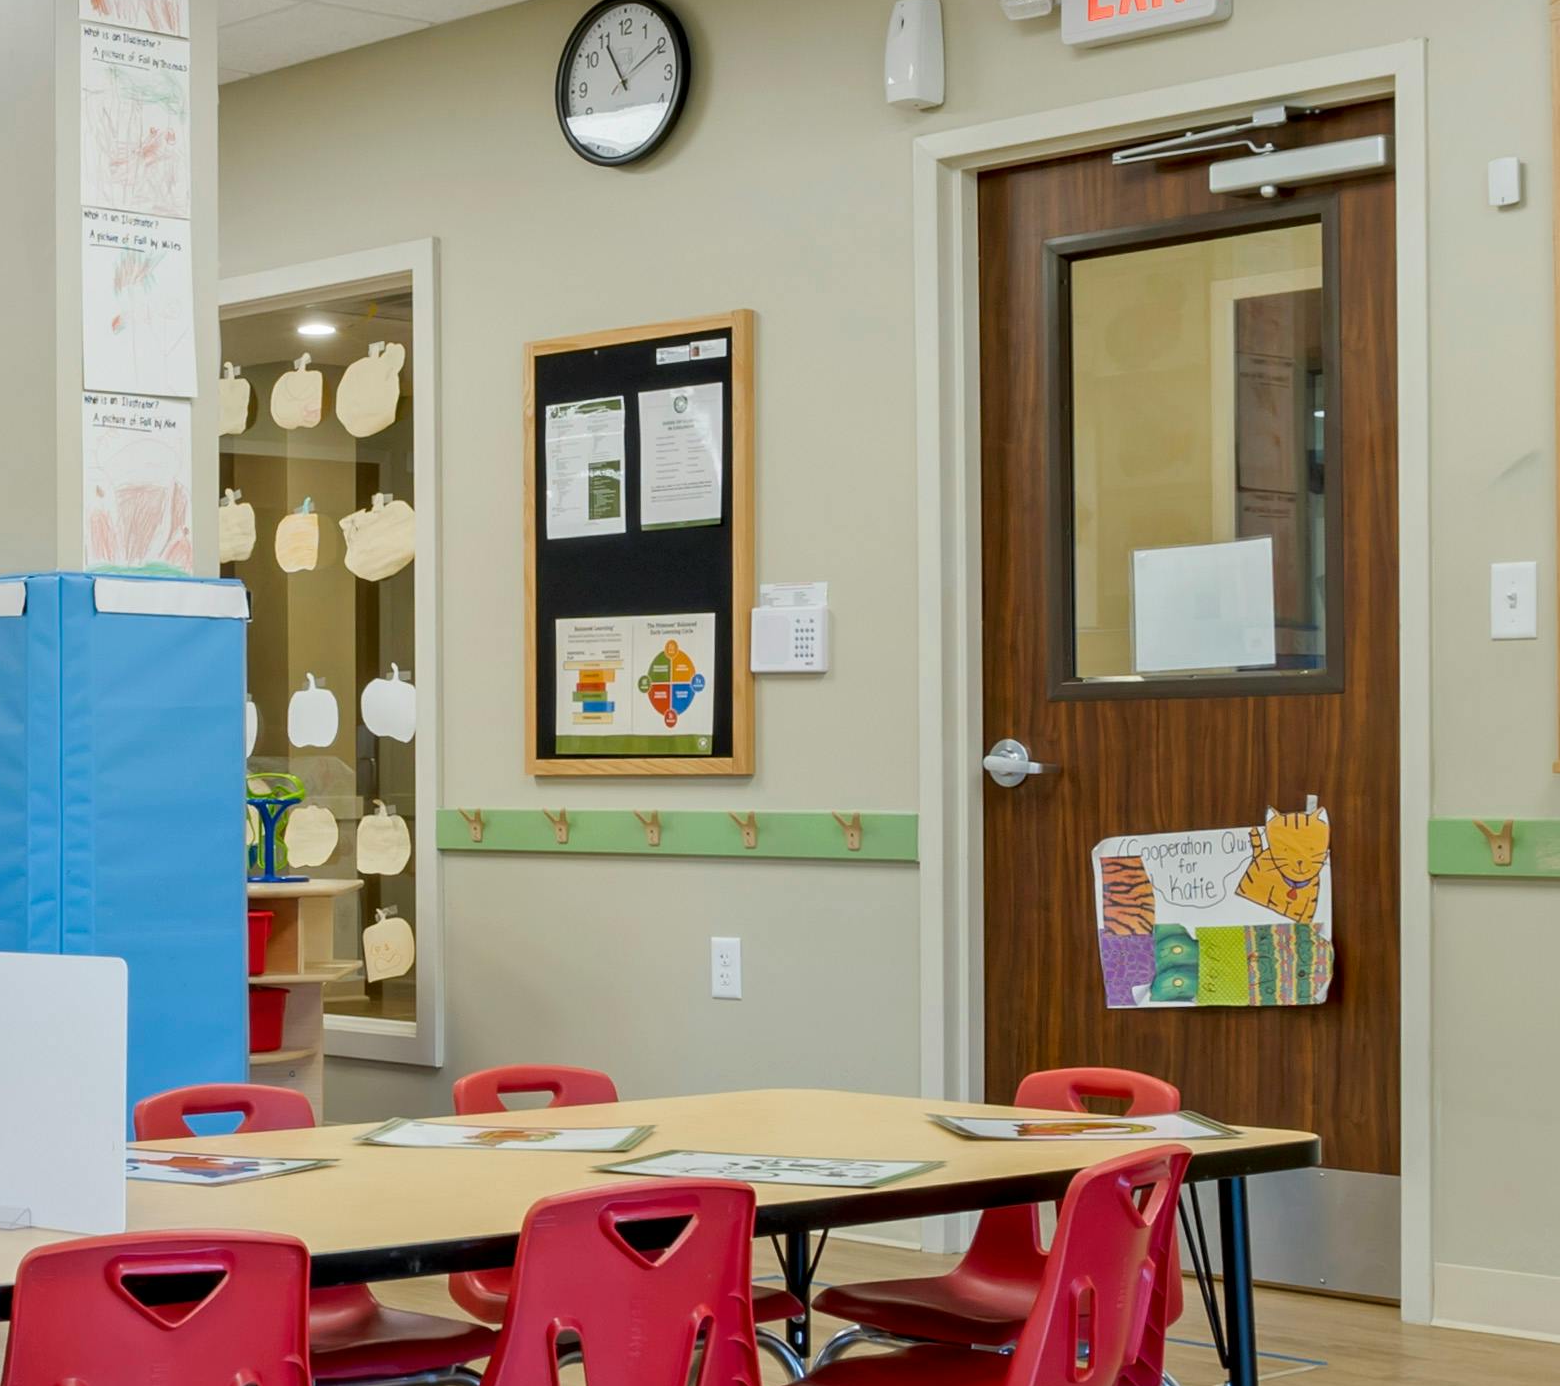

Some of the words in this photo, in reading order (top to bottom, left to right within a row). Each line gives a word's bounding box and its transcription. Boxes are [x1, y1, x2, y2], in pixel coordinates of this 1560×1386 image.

[619, 17, 633, 36] 12
[642, 23, 649, 40] 1
[598, 31, 611, 50] 11
[657, 36, 667, 55] 2
[92, 46, 99, 55] A
[101, 49, 125, 61] picture
[128, 51, 136, 61] of
[138, 54, 151, 64] Fall
[152, 59, 161, 69] by
[161, 59, 188, 73] Thomas
[585, 50, 599, 69] 10
[664, 63, 674, 82] 3
[578, 81, 588, 99] 9
[1125, 834, 1213, 870] Cooperation
[1178, 858, 1198, 873] for
[1169, 874, 1217, 902] Katie
